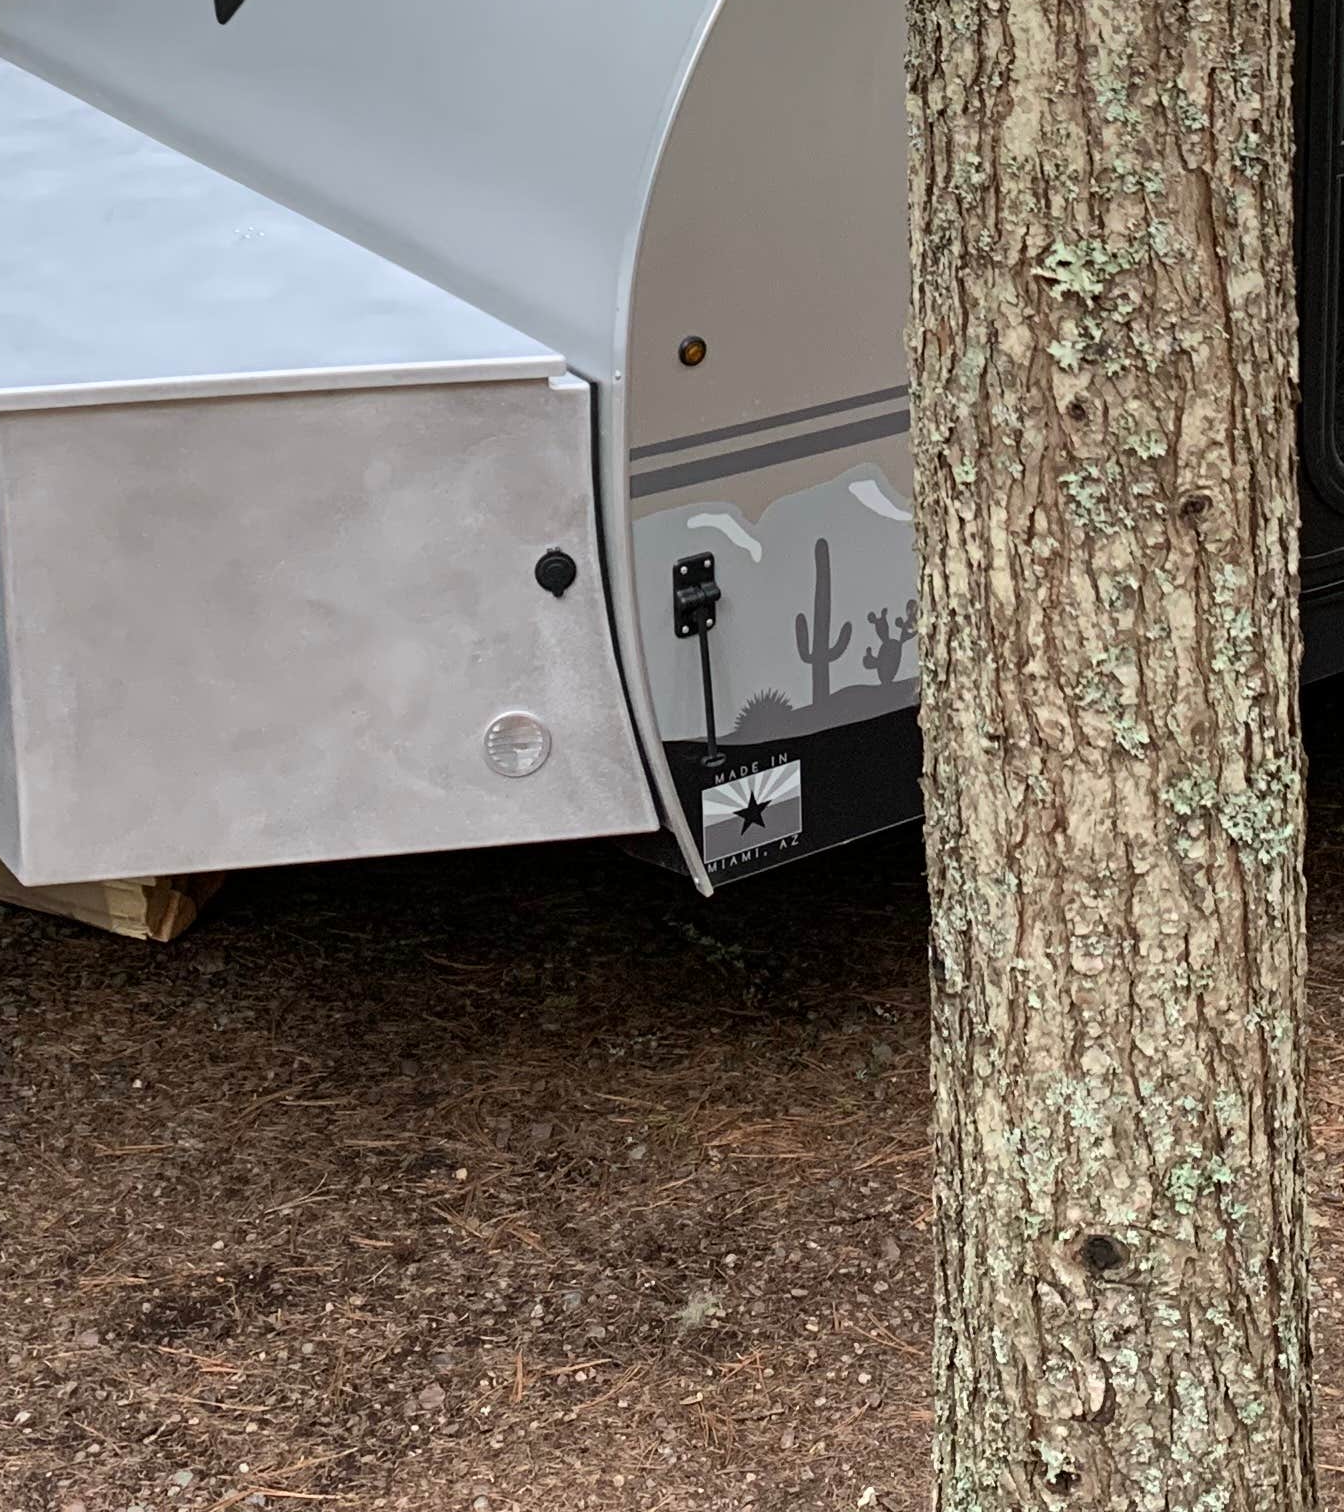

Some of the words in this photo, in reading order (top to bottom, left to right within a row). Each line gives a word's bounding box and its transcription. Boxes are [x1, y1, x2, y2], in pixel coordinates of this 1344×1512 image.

[715, 762, 759, 784] MADE
[771, 753, 788, 767] IN
[708, 848, 768, 873] MIAMI,
[779, 836, 799, 849] AZ
